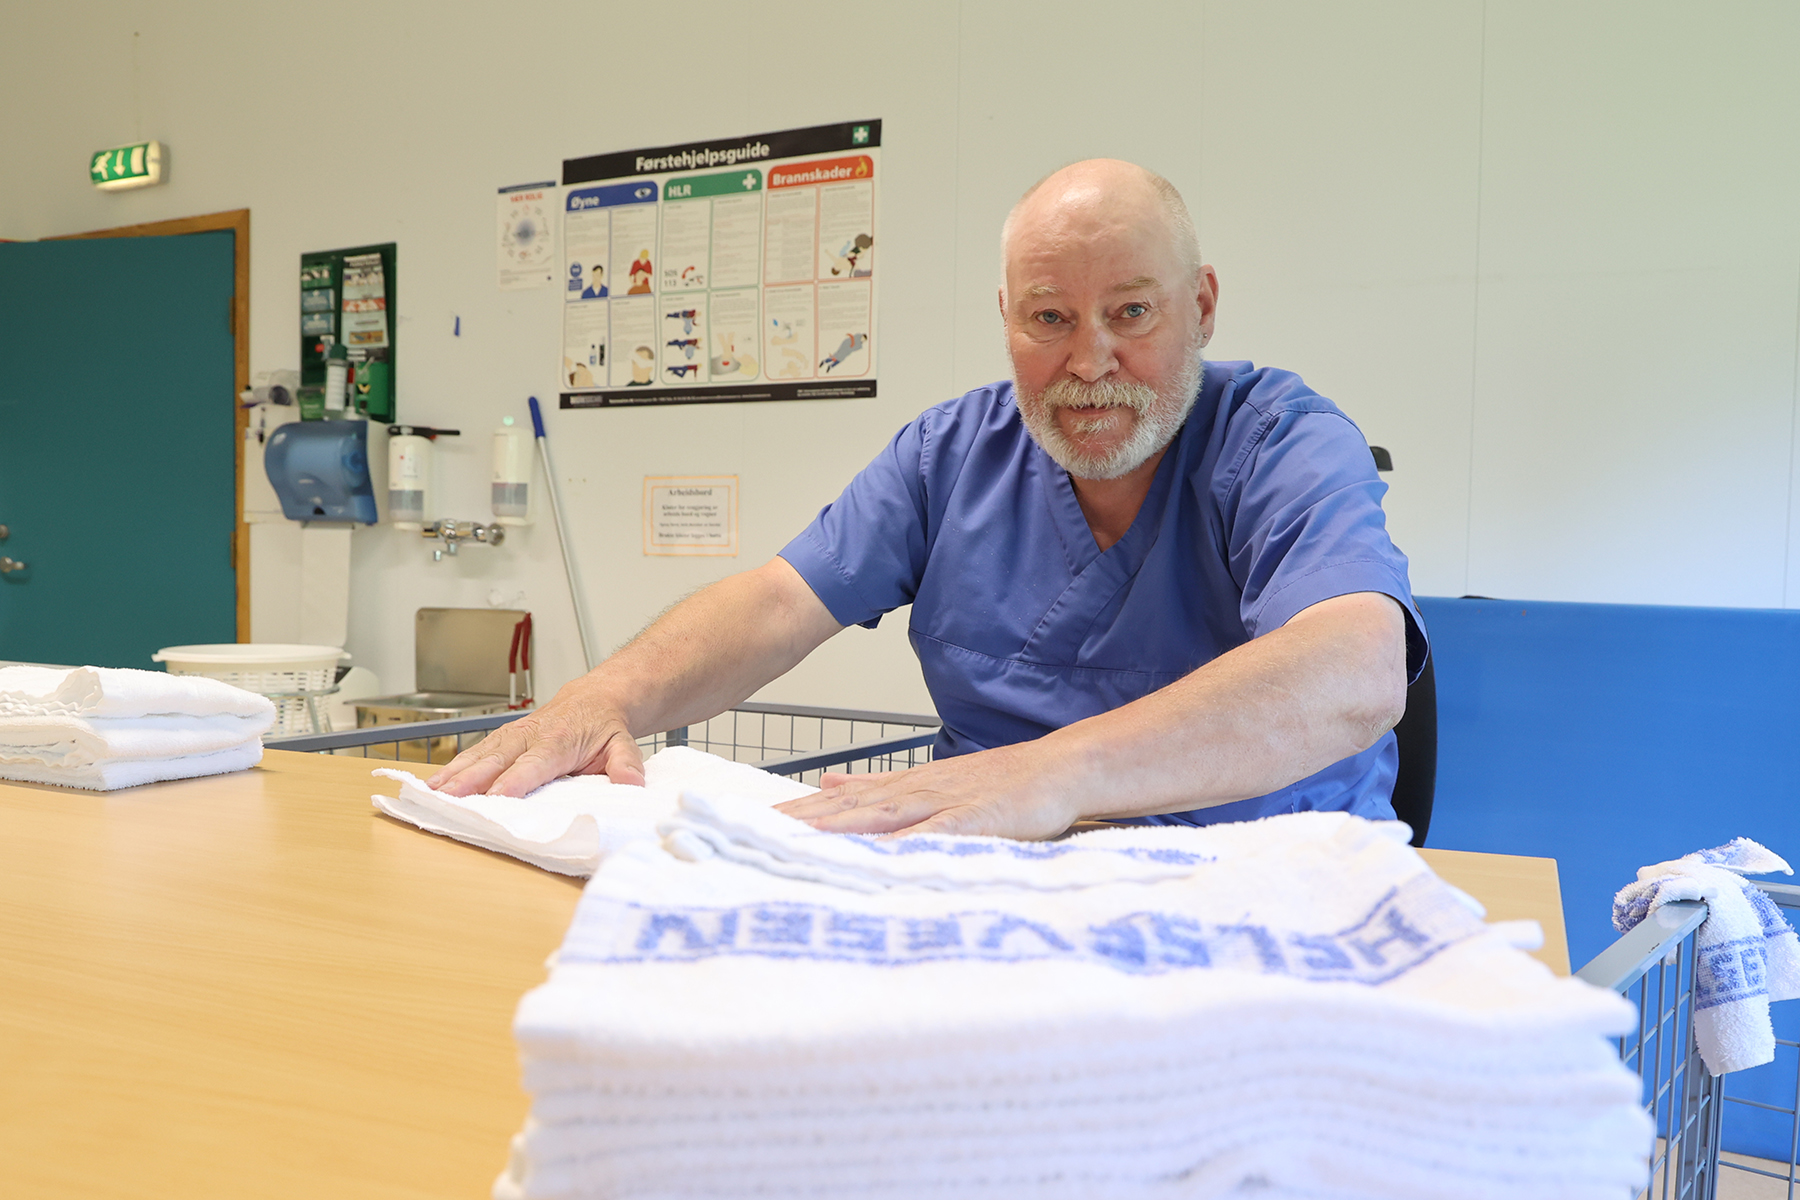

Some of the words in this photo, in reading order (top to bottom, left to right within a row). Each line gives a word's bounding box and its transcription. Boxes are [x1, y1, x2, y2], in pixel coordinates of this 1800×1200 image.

[635, 141, 770, 172] Førstehjelpsguide
[772, 166, 853, 187] Brannskader
[668, 184, 692, 198] HLR
[570, 196, 600, 210] Øyne
[634, 906, 1431, 972] HELSEVESEN
